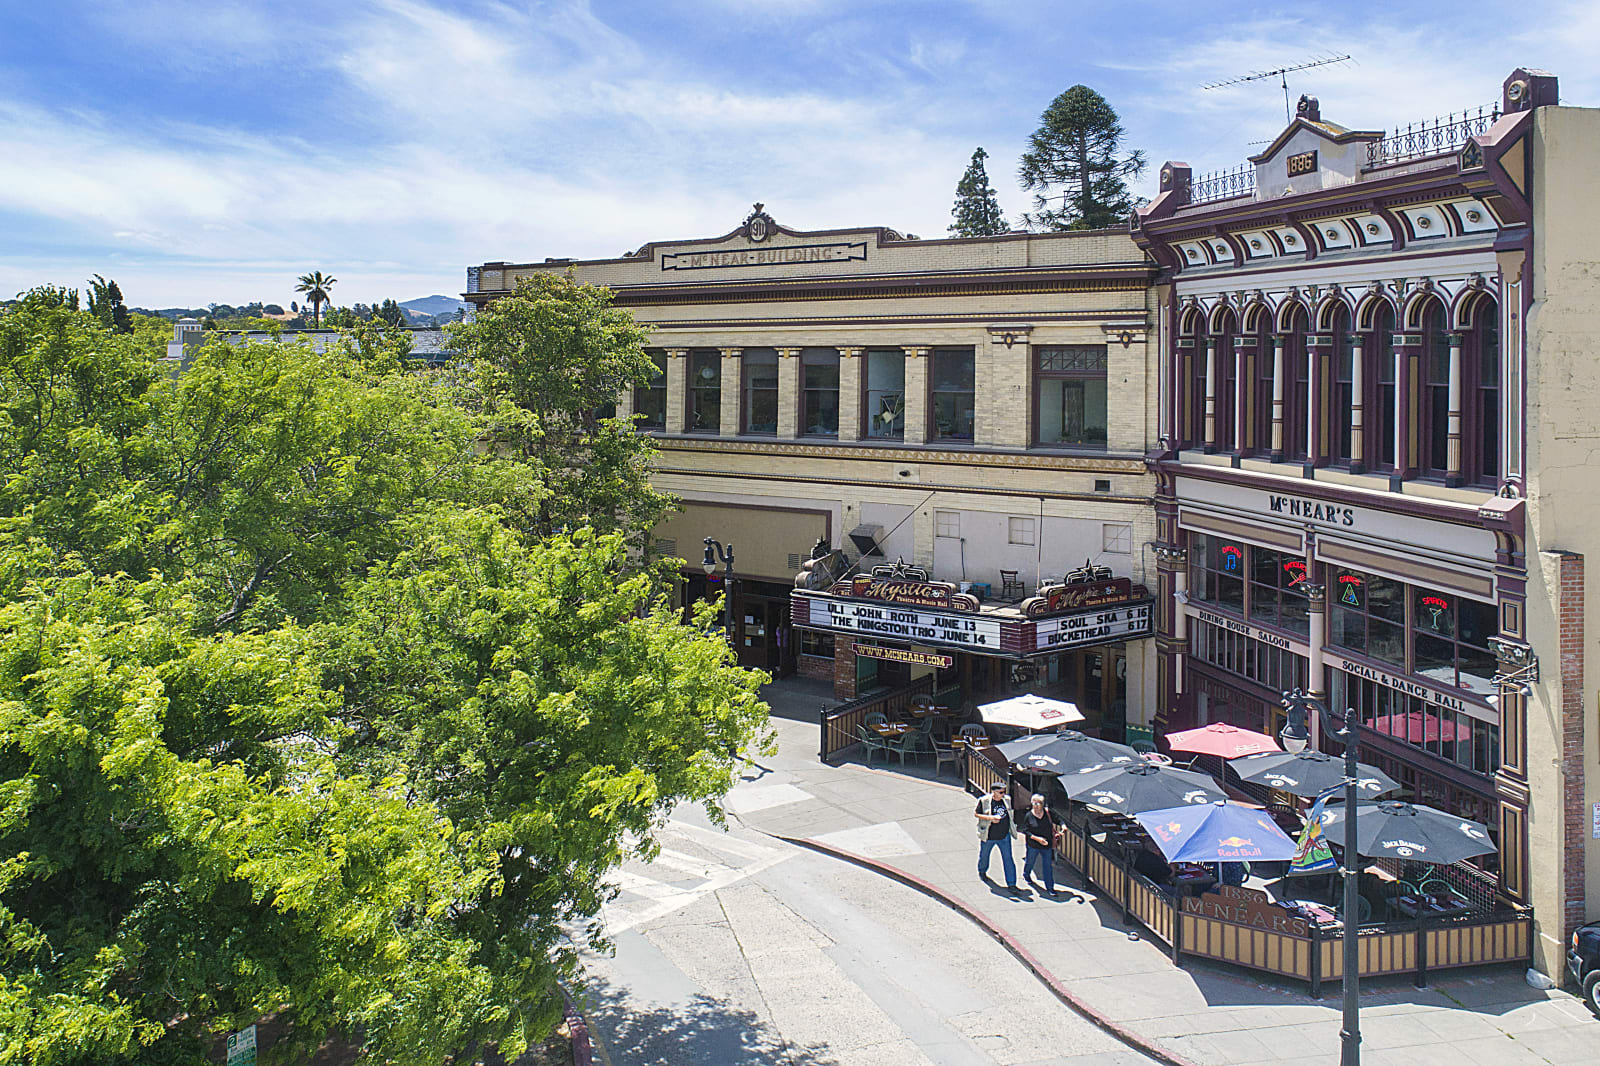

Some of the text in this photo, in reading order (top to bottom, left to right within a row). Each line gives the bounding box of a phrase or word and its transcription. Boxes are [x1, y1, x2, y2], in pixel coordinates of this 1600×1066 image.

[1288, 153, 1313, 174] 1886
[758, 247, 832, 263] BUILDING
[1269, 495, 1354, 526] McNEAR'S
[865, 582, 932, 601] Mystic
[827, 603, 976, 631] ULI JOHN ROTH JUNE 13
[1060, 617, 1088, 630] SOUL
[1096, 613, 1117, 625] SKA
[831, 615, 986, 644] THE KINGSTON TRIO JUNE 14
[1047, 625, 1110, 645] BUCKETHEAD
[1199, 611, 1290, 649] DINING HOUSE SALOON
[857, 645, 946, 667] WWW.MCNEARS.COM
[1342, 660, 1465, 711] SOCIAL & DANCE HALL
[1217, 848, 1262, 856] Red Bull
[1223, 886, 1264, 904] 1886
[229, 1037, 235, 1047] 2
